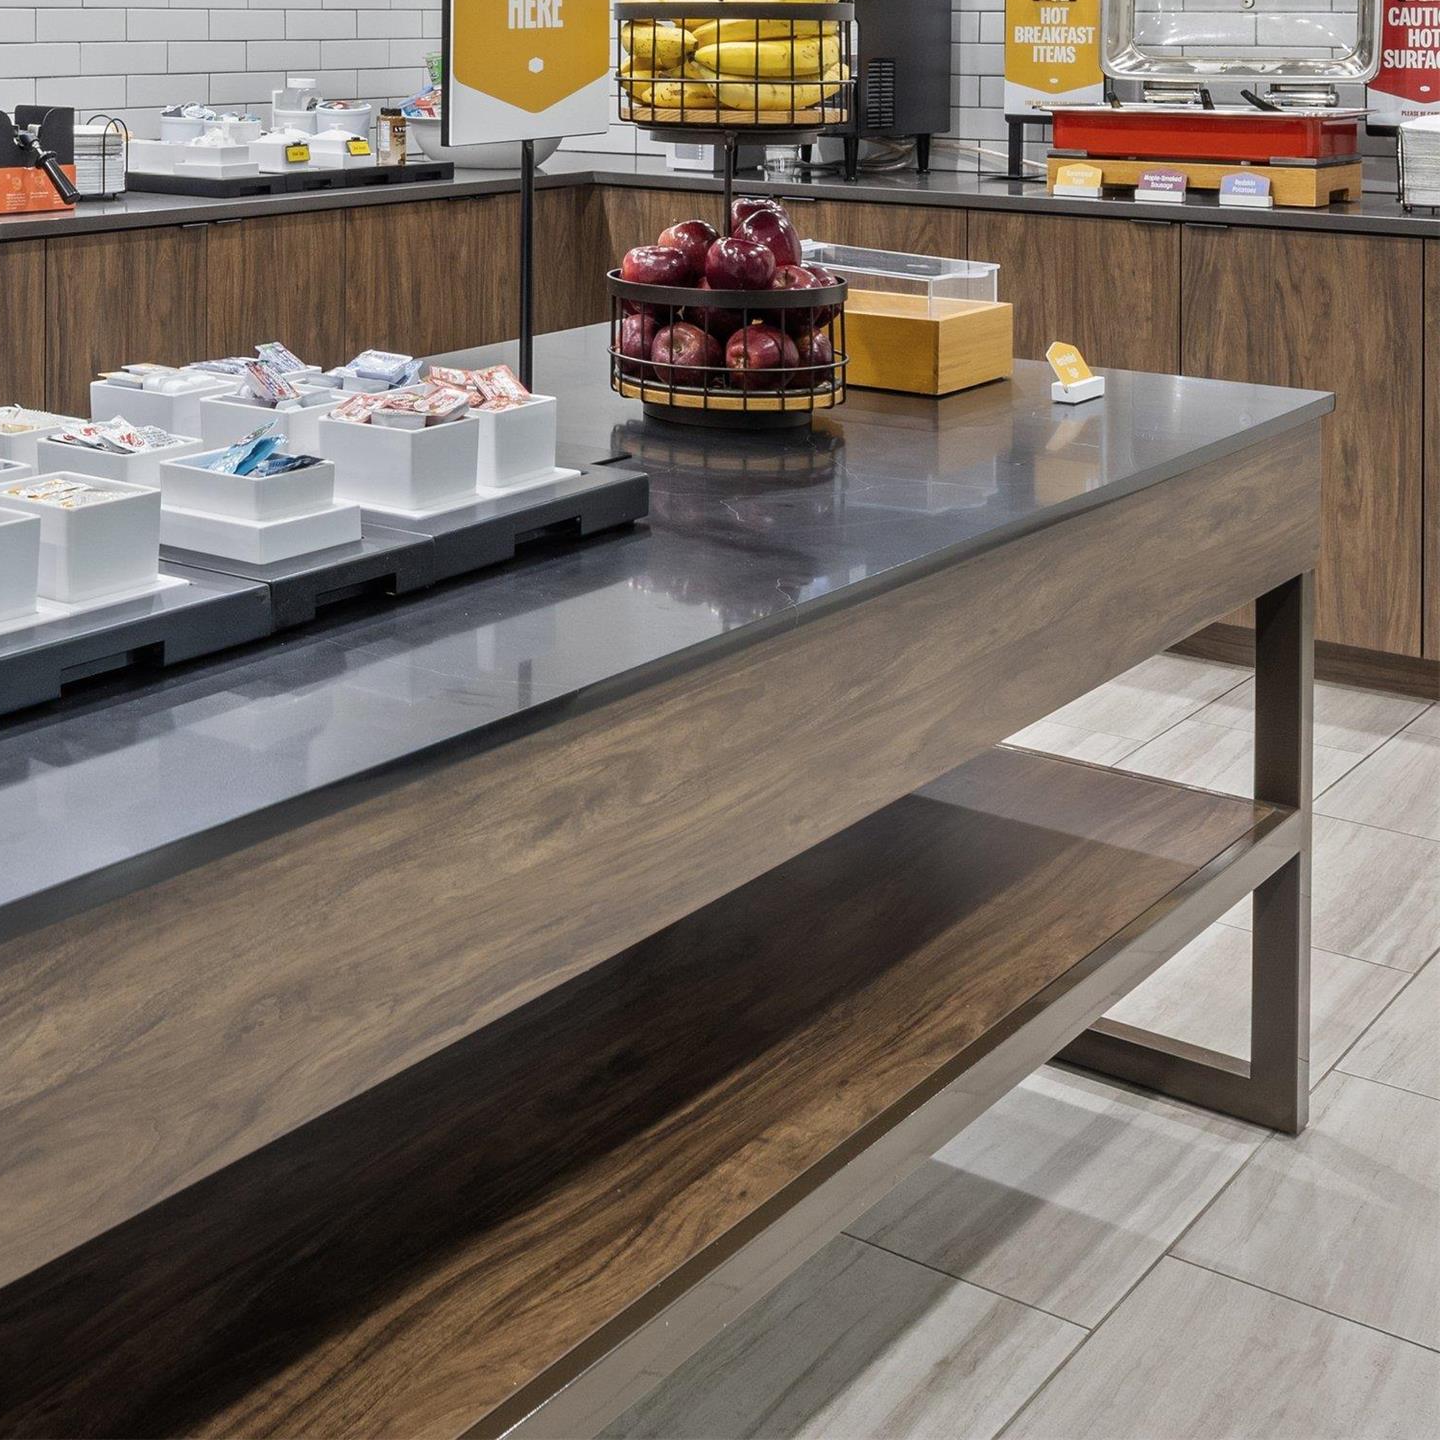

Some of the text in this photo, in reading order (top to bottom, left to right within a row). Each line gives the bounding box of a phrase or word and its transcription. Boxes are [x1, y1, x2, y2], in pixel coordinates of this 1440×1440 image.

[1040, 7, 1070, 25] HOT
[1388, 7, 1440, 27] CAUTI
[1014, 26, 1096, 44] BREAKFAST
[1408, 28, 1440, 48] HOT
[1032, 46, 1076, 64] ITEMS
